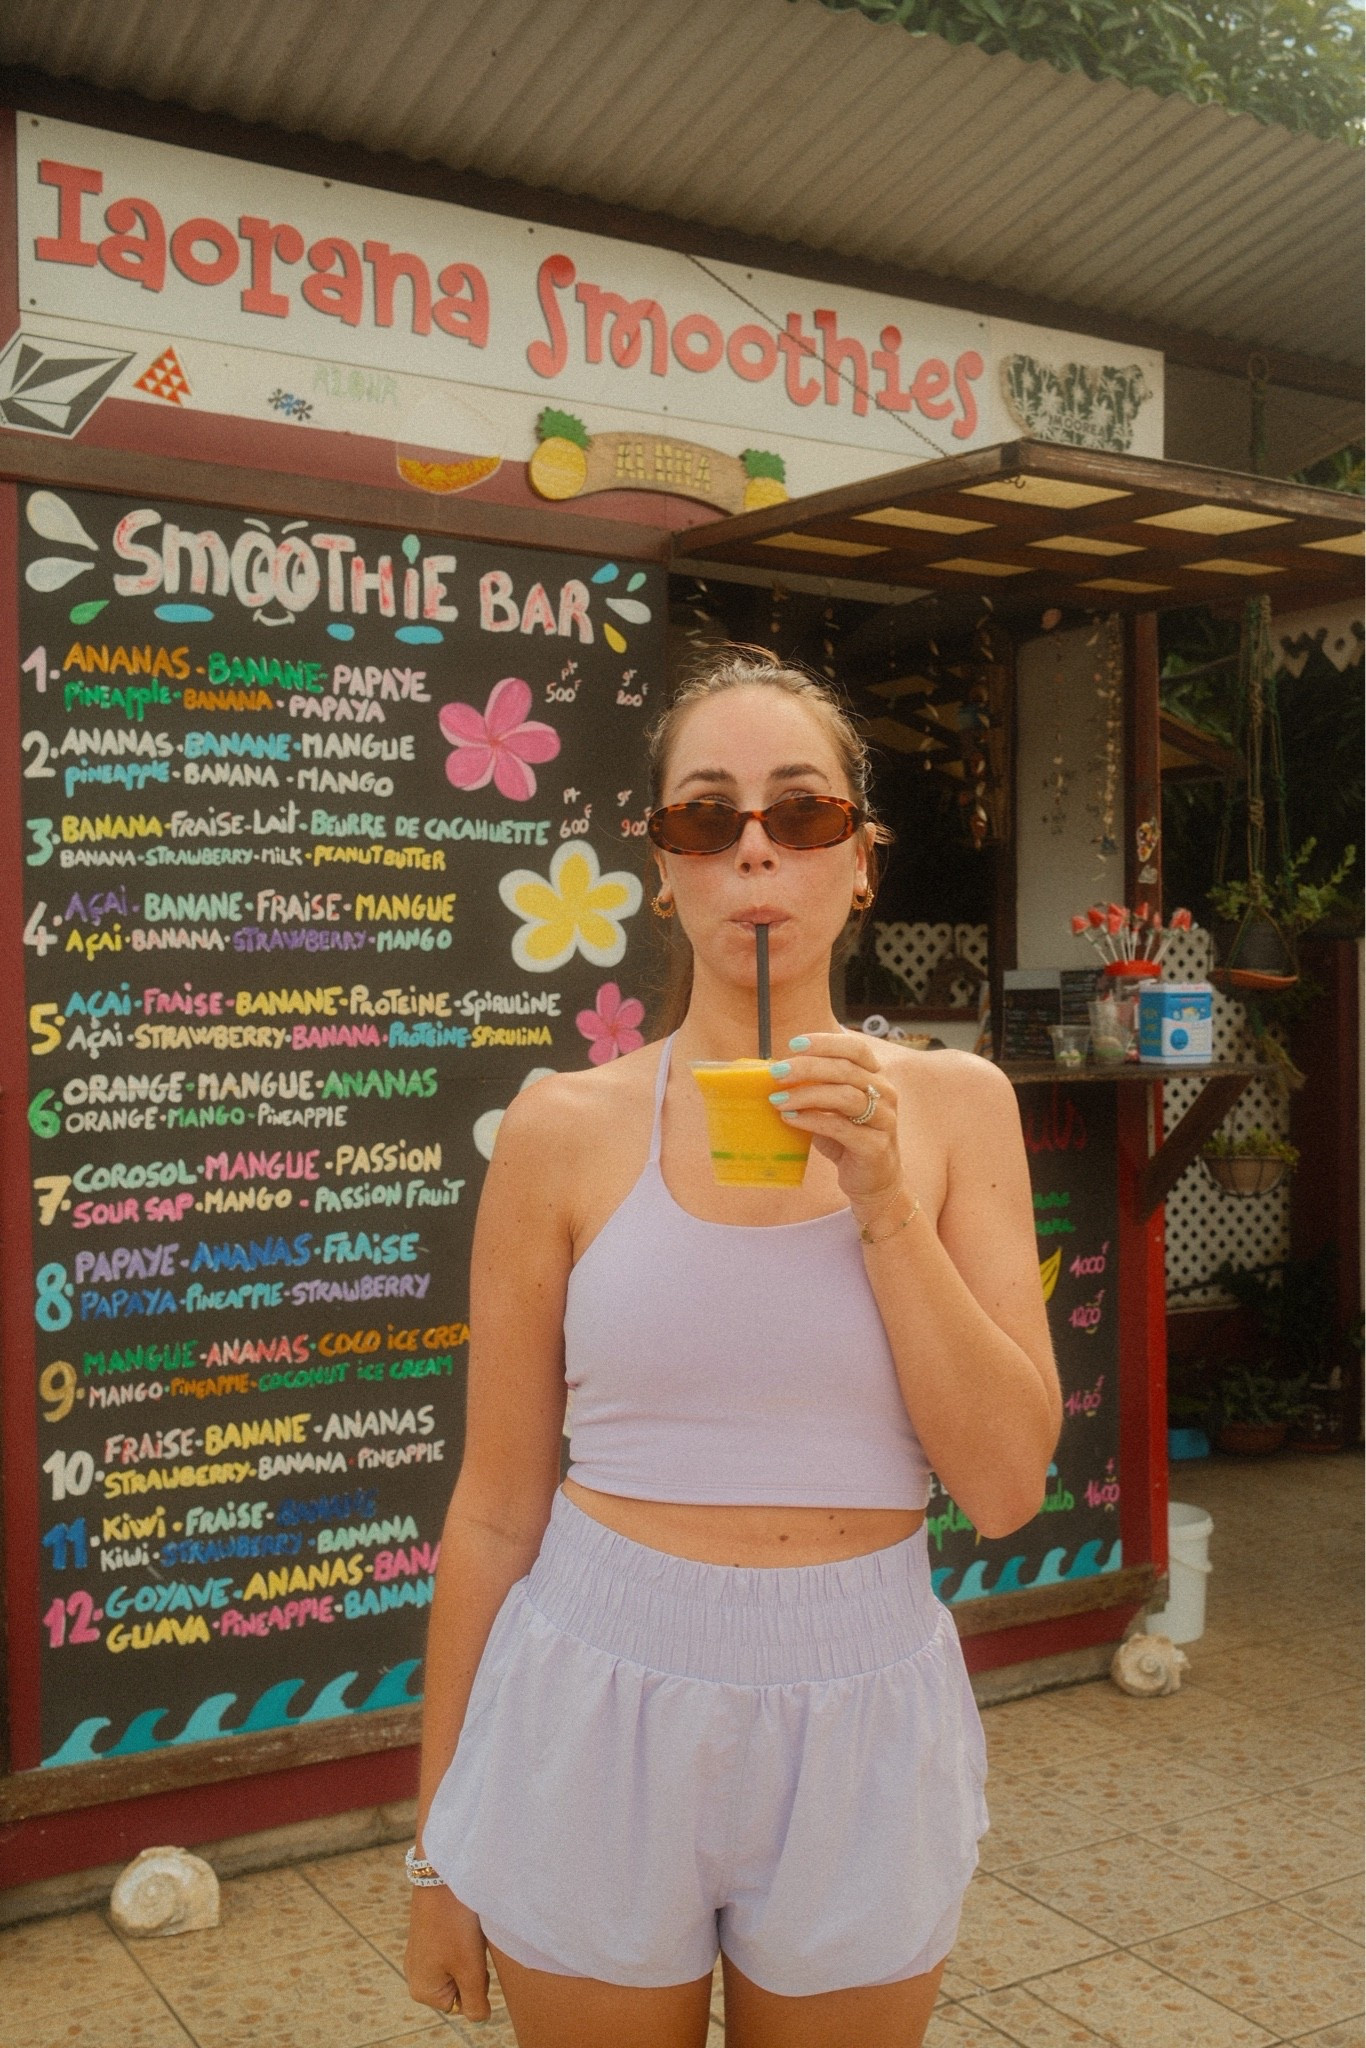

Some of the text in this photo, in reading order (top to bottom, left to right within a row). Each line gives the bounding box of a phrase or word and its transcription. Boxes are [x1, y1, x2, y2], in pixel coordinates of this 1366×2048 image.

[34, 158, 985, 440] Iaorana Smoothies
[480, 570, 594, 644] BAR
[63, 642, 190, 680] ANANAS
[208, 652, 324, 693] BANANE
[333, 664, 432, 702] PAPAYE
[183, 687, 273, 712] BANANA
[289, 695, 386, 722] PAPAYA
[60, 727, 174, 758] ANANAS
[184, 731, 291, 761] BANANE
[302, 732, 415, 761] MANGUE
[184, 762, 279, 787] BANANA
[298, 766, 394, 797] MANGO
[62, 814, 163, 843] BANANA
[395, 816, 420, 839] DE
[60, 849, 137, 868] BANANA
[144, 891, 243, 922] BANANE
[355, 893, 456, 923] MANGUE
[131, 927, 225, 952] BANANA
[377, 927, 452, 953] MANGO
[235, 986, 343, 1017] BANANE
[134, 1023, 286, 1050] STRAWBERRY
[292, 1023, 381, 1050] BANANA
[63, 1071, 187, 1105] ORANGE
[198, 1071, 314, 1101] MANGUE
[322, 1067, 438, 1099] ANANAS
[65, 1106, 158, 1133] ORANGE
[167, 1105, 245, 1129] MANGO
[73, 1158, 197, 1193] COROSOL
[205, 1149, 321, 1182] MANGUE
[72, 1198, 140, 1229] SOUR
[144, 1192, 195, 1222] SAP
[204, 1186, 293, 1214] MANGO
[75, 1243, 180, 1284] PAPAYE
[189, 1232, 313, 1273] ANANAS
[80, 1288, 178, 1321] PAPAYA
[291, 1272, 431, 1306] STRAWBERRY
[84, 1340, 199, 1376] MANGUE
[205, 1333, 310, 1368] ANANAS
[318, 1329, 382, 1357] COCO
[89, 1382, 164, 1409] MANGO
[258, 1362, 350, 1392] COCONUT
[389, 1355, 453, 1379] CREAM
[205, 1413, 311, 1456] BANANE
[322, 1405, 436, 1443] ANANAS
[104, 1461, 250, 1499] STRAWBERRY
[258, 1451, 348, 1481] BANANA
[317, 1515, 419, 1554] BANANA
[105, 1577, 233, 1619] GOYAVE
[243, 1553, 364, 1601] ANANAS
[106, 1614, 211, 1653] GUAVA
